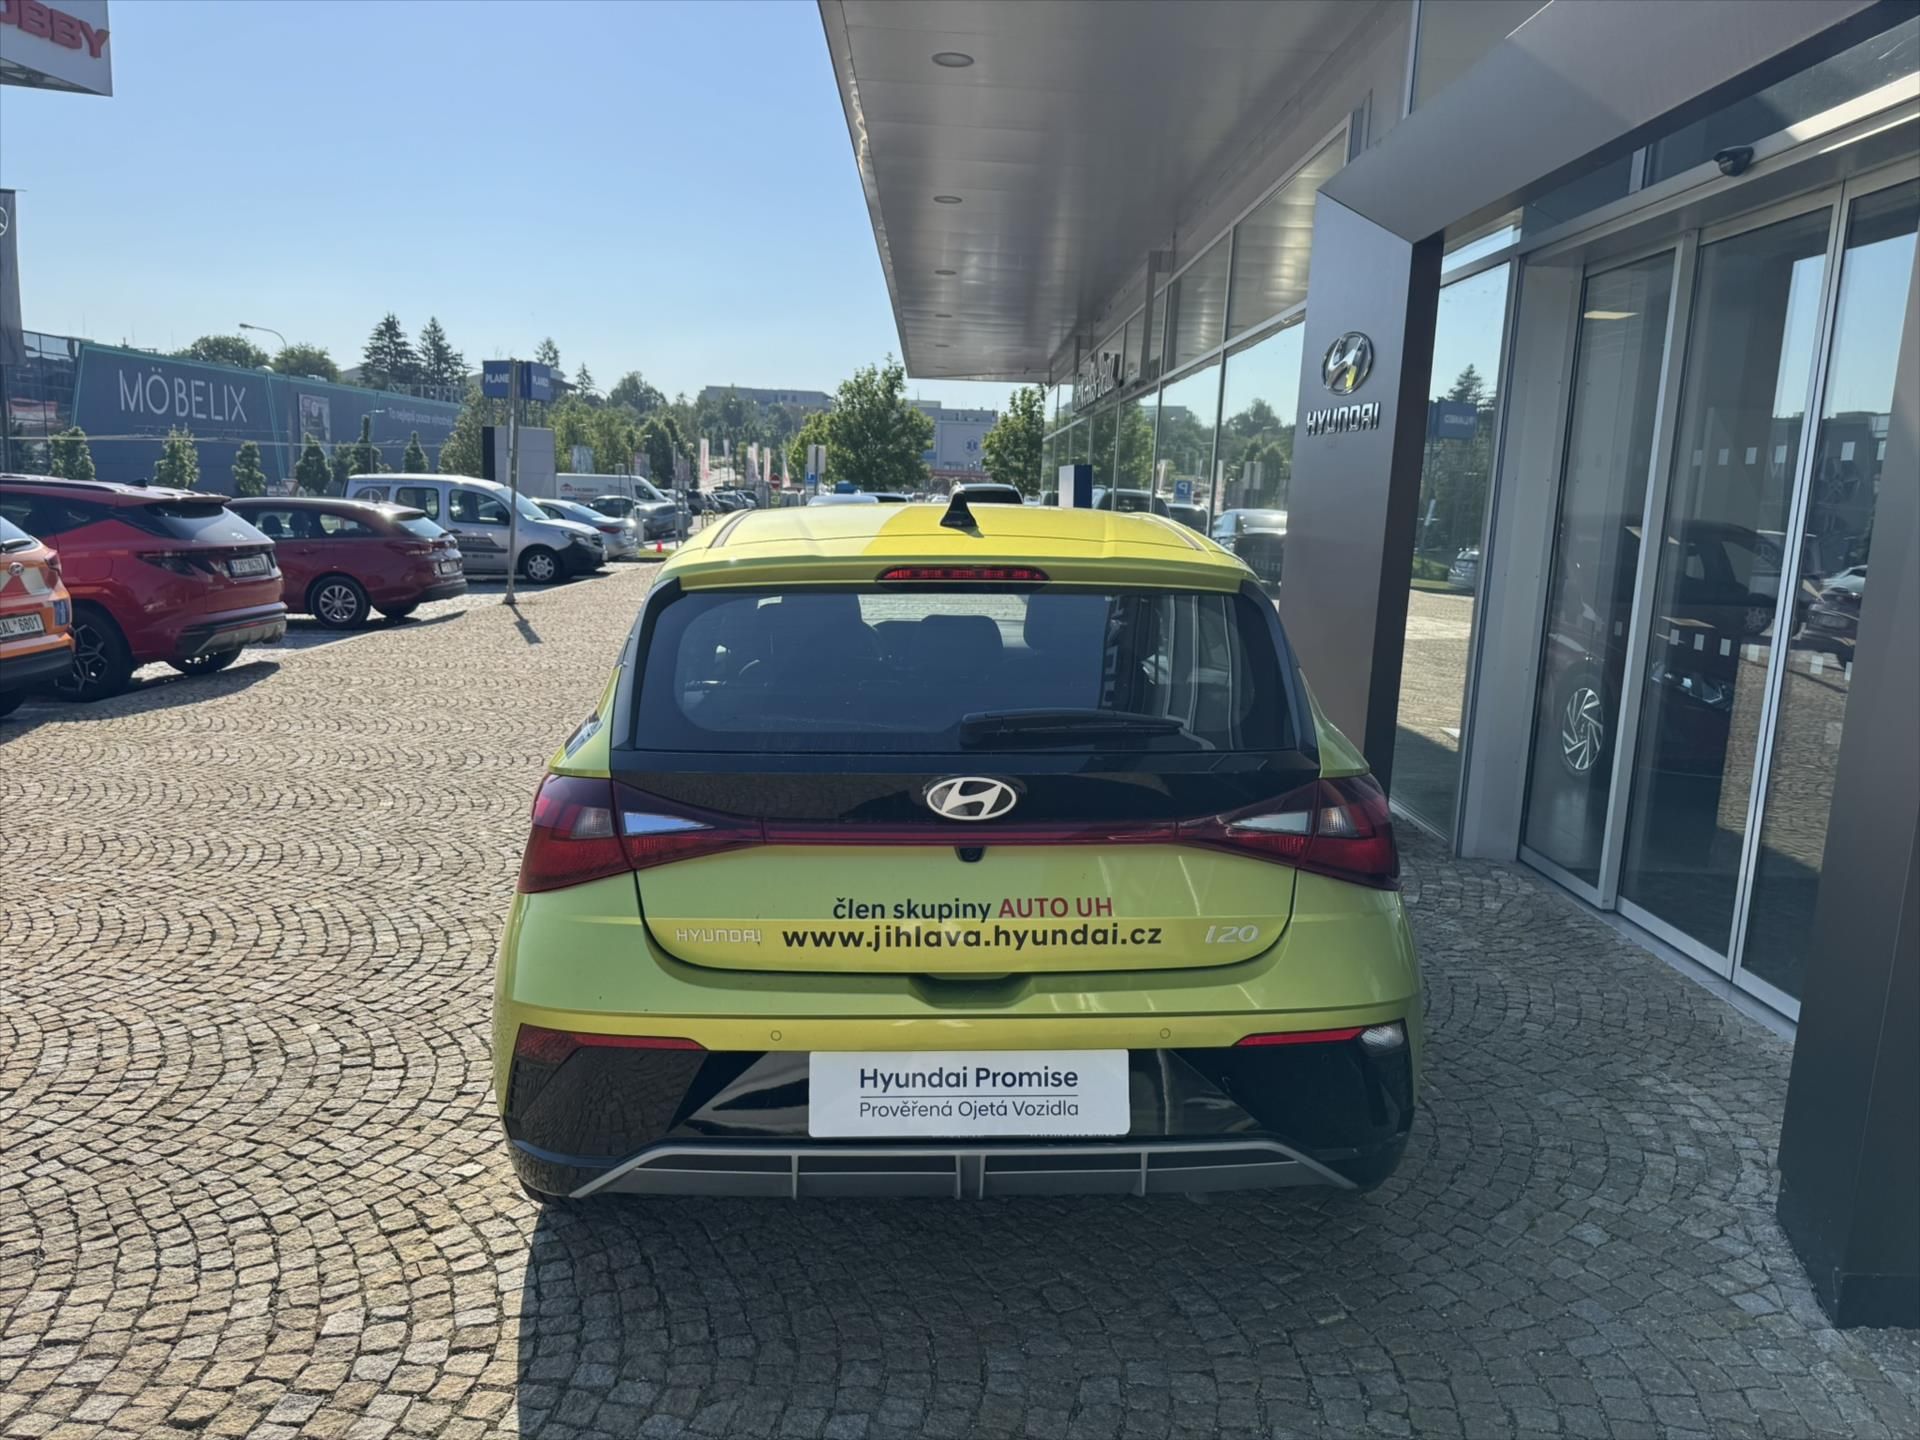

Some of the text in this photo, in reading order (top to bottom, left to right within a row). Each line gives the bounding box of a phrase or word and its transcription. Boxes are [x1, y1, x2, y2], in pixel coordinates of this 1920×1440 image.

[119, 366, 248, 423] MÖBELIX
[1306, 401, 1381, 436] HYUNDAI
[833, 897, 1114, 923] člen skupiny AUTO UH
[675, 927, 761, 944] HYUNDAI
[783, 923, 1162, 952] www.jihlava.hyundai.cz
[860, 1066, 1079, 1093] Hyundai Promise
[860, 1100, 1079, 1120] Prověřená Ojetá Vozidla
